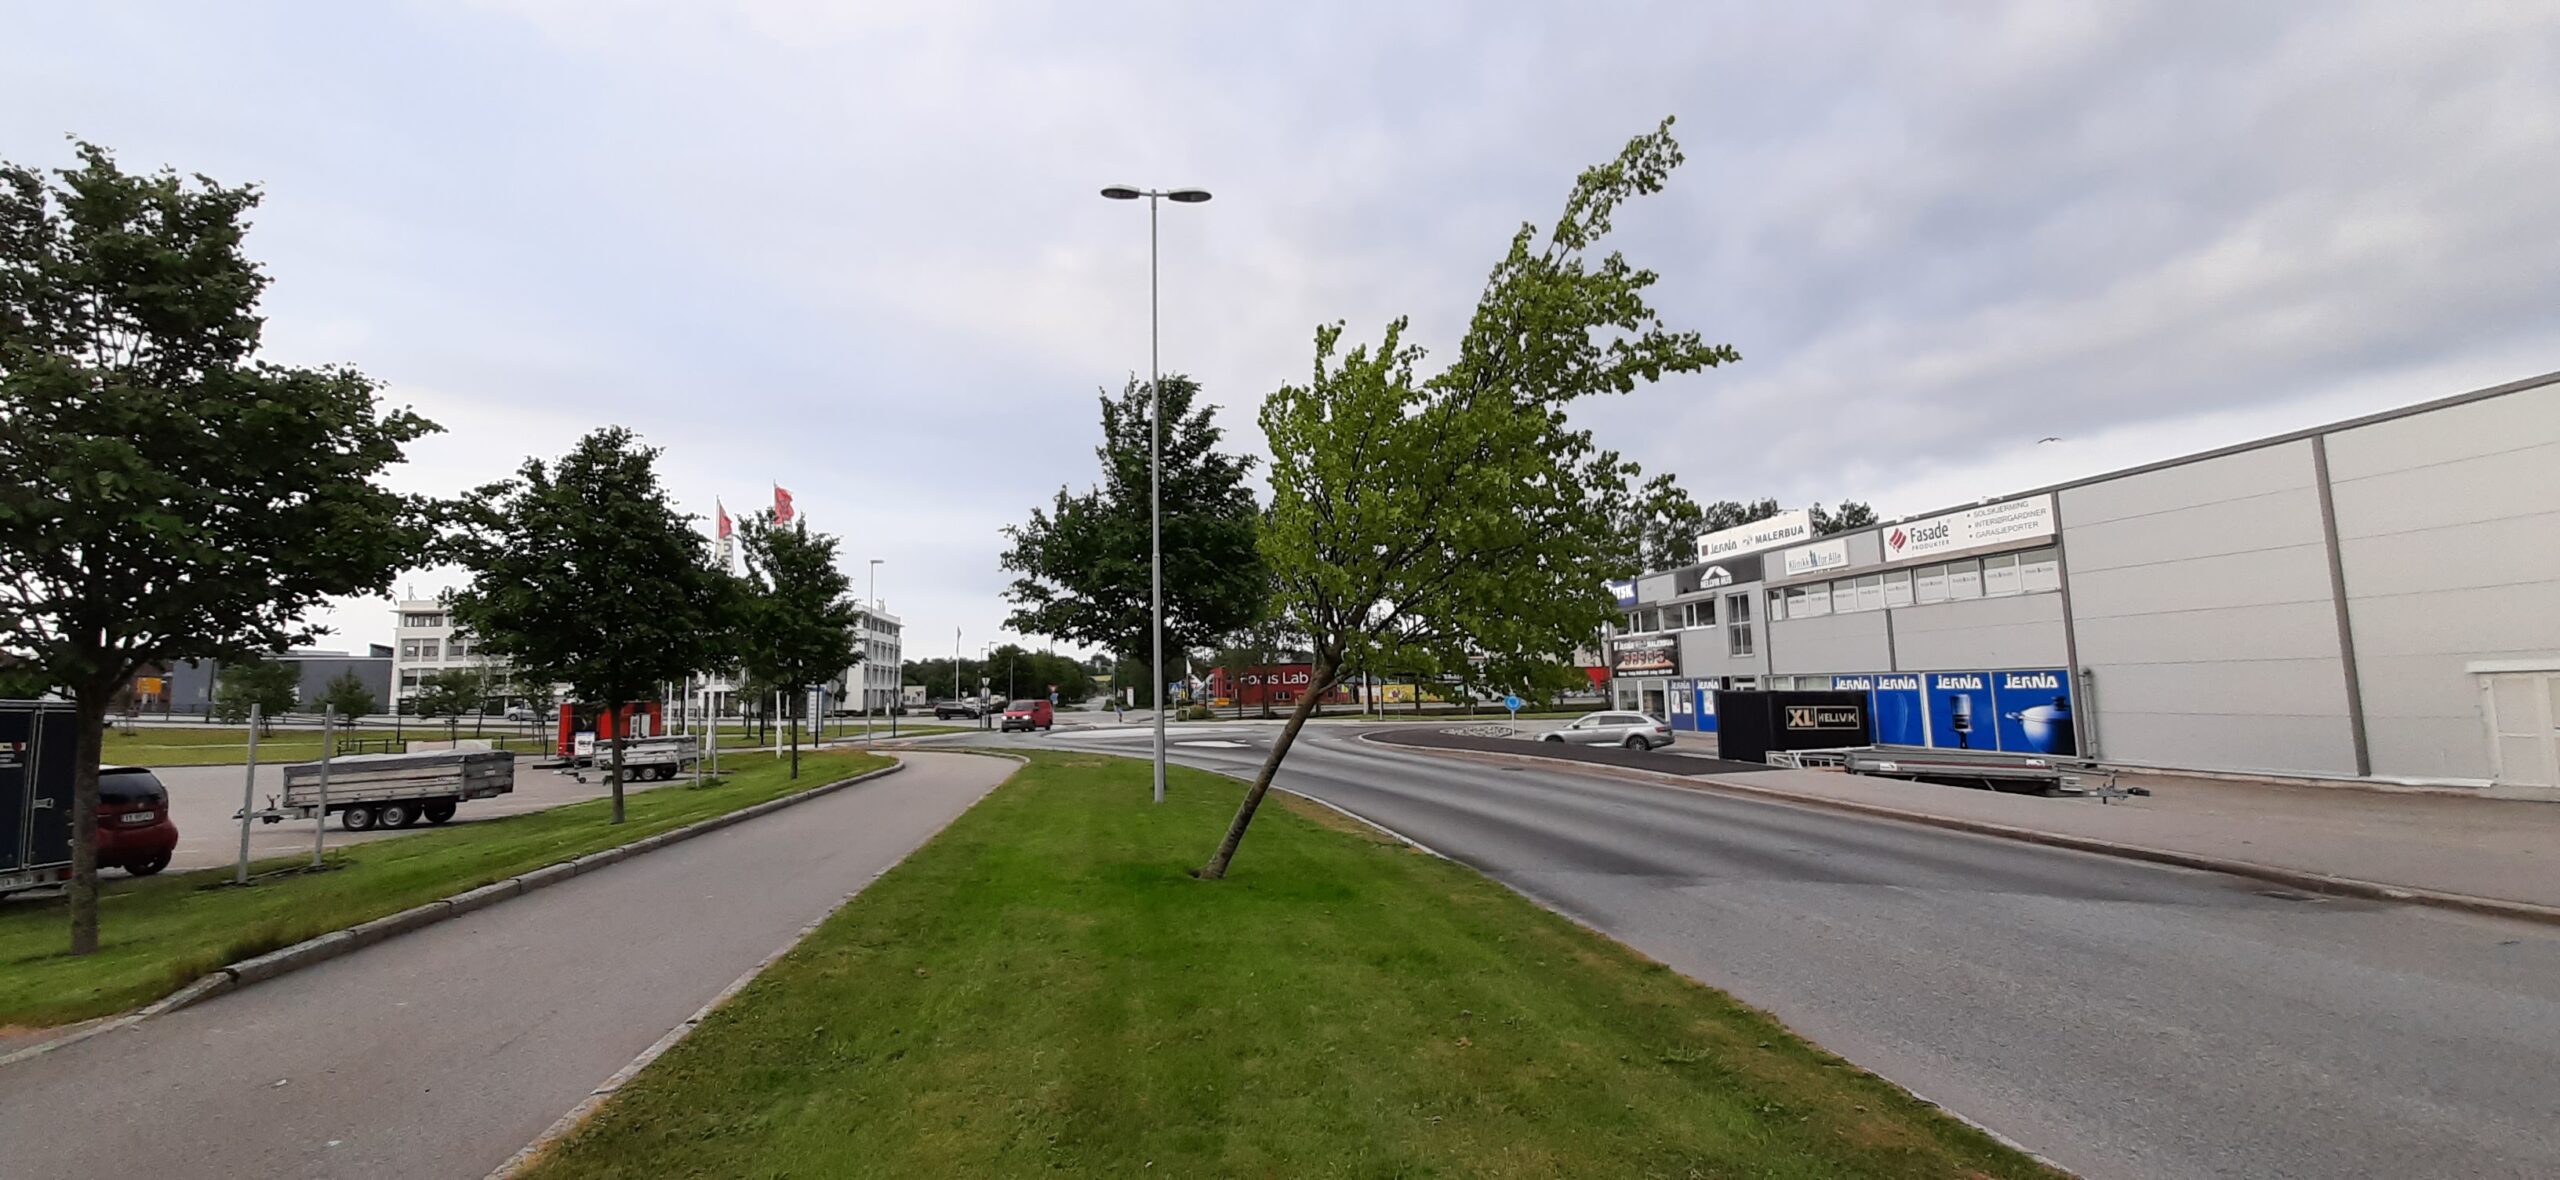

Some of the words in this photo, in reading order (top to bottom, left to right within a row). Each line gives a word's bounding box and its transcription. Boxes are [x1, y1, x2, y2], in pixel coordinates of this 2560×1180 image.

[1973, 500, 2029, 519] SOLSKJERMING
[1755, 525, 1804, 544] MALERBUA
[1910, 520, 1949, 543] Fasade
[1911, 539, 1950, 551] PRODUKTER
[1282, 671, 1309, 685] Lab
[1788, 709, 1814, 727] XL
